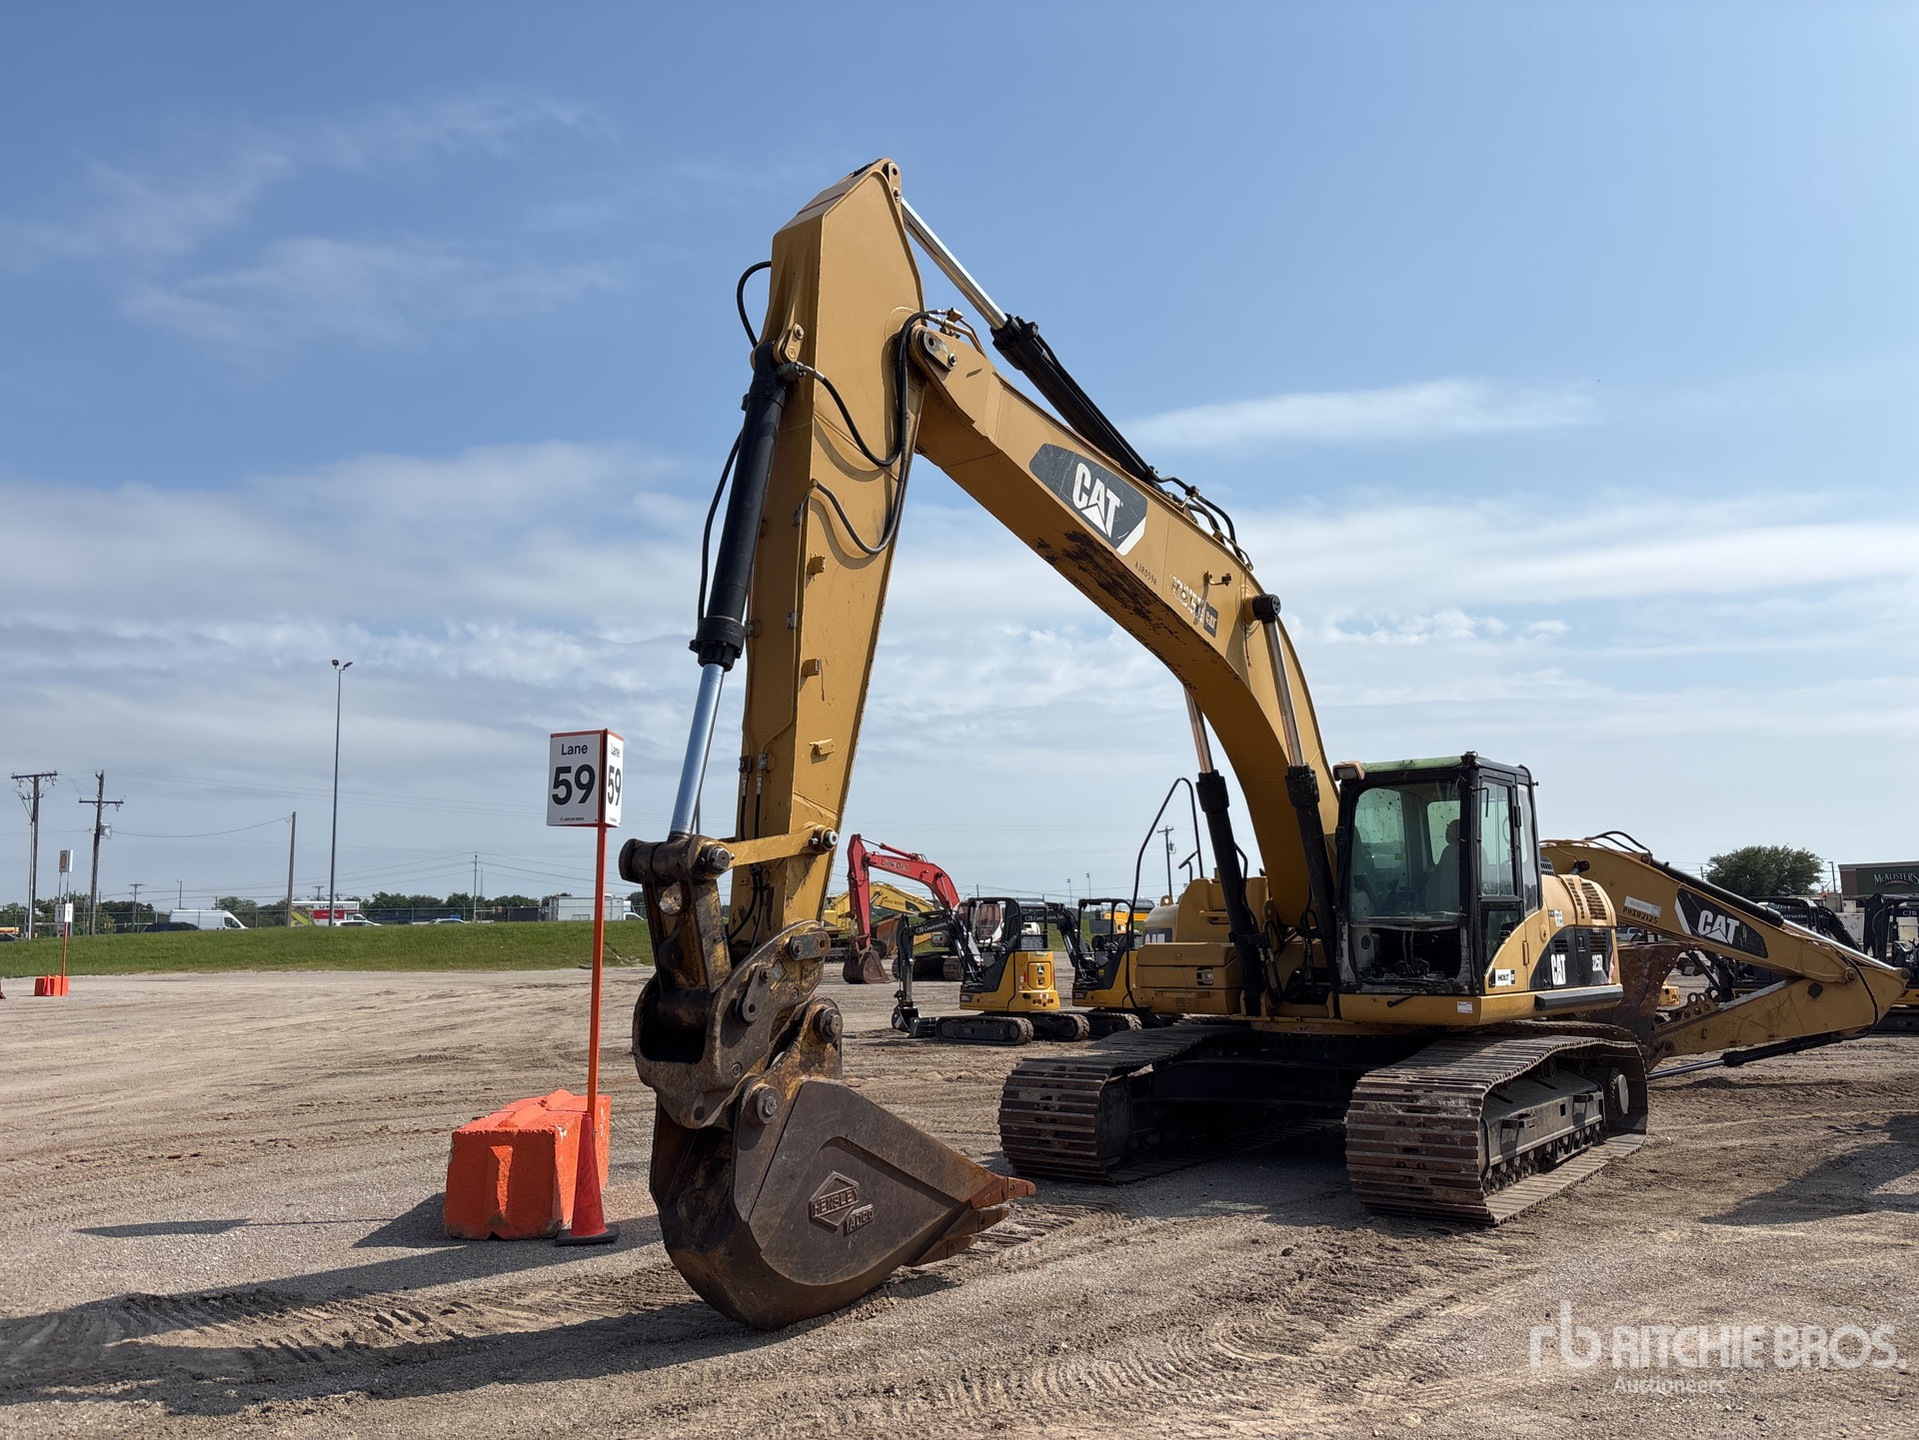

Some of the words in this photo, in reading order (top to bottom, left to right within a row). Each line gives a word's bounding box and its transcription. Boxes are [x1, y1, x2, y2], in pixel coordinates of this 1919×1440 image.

[1072, 462, 1121, 538] CAT
[561, 743, 588, 756] Lane
[551, 763, 596, 806] 59
[607, 764, 621, 807] 59
[1697, 909, 1740, 945] CAT
[1497, 973, 1509, 981] HOLT
[1551, 953, 1566, 985] CAT
[813, 1187, 859, 1216] HENSLEY
